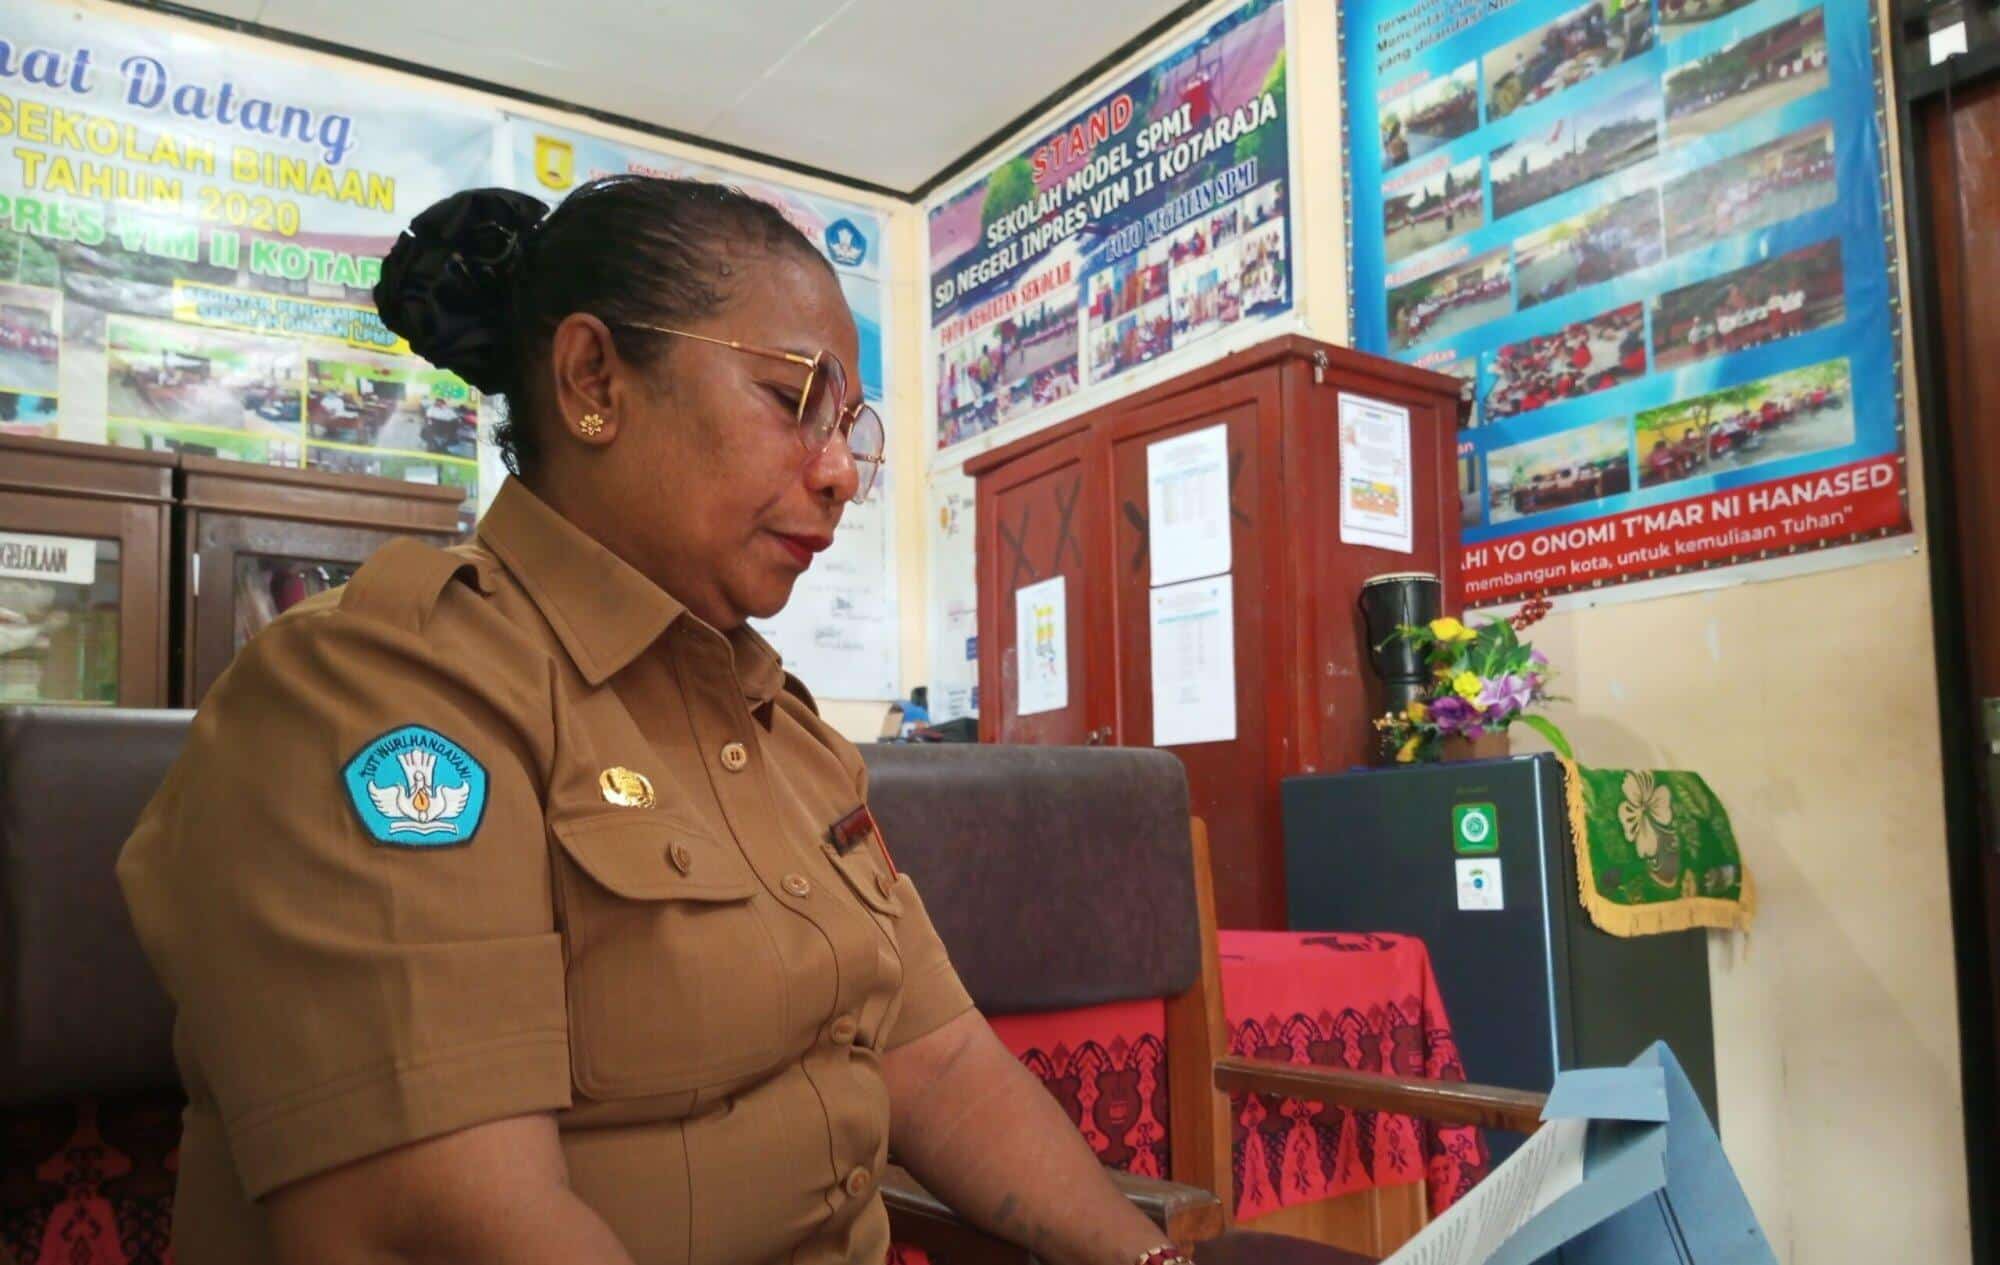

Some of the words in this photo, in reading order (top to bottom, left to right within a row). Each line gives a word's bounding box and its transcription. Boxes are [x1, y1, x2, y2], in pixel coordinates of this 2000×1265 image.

[121, 56, 353, 164] Datang
[1031, 94, 1134, 184] STAND
[15, 148, 182, 211] TAHUN
[202, 186, 301, 238] 2020
[232, 147, 395, 213] BINAAN
[935, 280, 955, 308] SD
[957, 243, 1018, 296] NEGERI
[1021, 201, 1088, 257] INPRES
[1090, 176, 1130, 219] VIM
[1134, 162, 1154, 197] II
[1159, 93, 1278, 182] KOTARAJA
[986, 187, 1062, 248] SEKOLAH
[1066, 143, 1133, 201] MODEL
[1135, 103, 1193, 158] SPMI
[118, 215, 199, 262] VIM
[209, 229, 240, 269] II
[0, 542, 68, 573] GELOLAAN
[1465, 564, 1566, 594] membangun
[1570, 556, 1613, 576] kota,
[1617, 542, 1671, 566] untuk
[1674, 523, 1776, 556] kemuliaan
[1781, 505, 1853, 536] Tuhan"
[1494, 541, 1526, 563] YO
[1532, 521, 1616, 556] ONOMI
[1622, 503, 1704, 538] T'MAR
[1712, 495, 1740, 520] NI
[1748, 463, 1894, 513] HANASED
[359, 756, 382, 779] TUT
[376, 736, 408, 760] WURI
[409, 734, 473, 781] HANDAYANI
